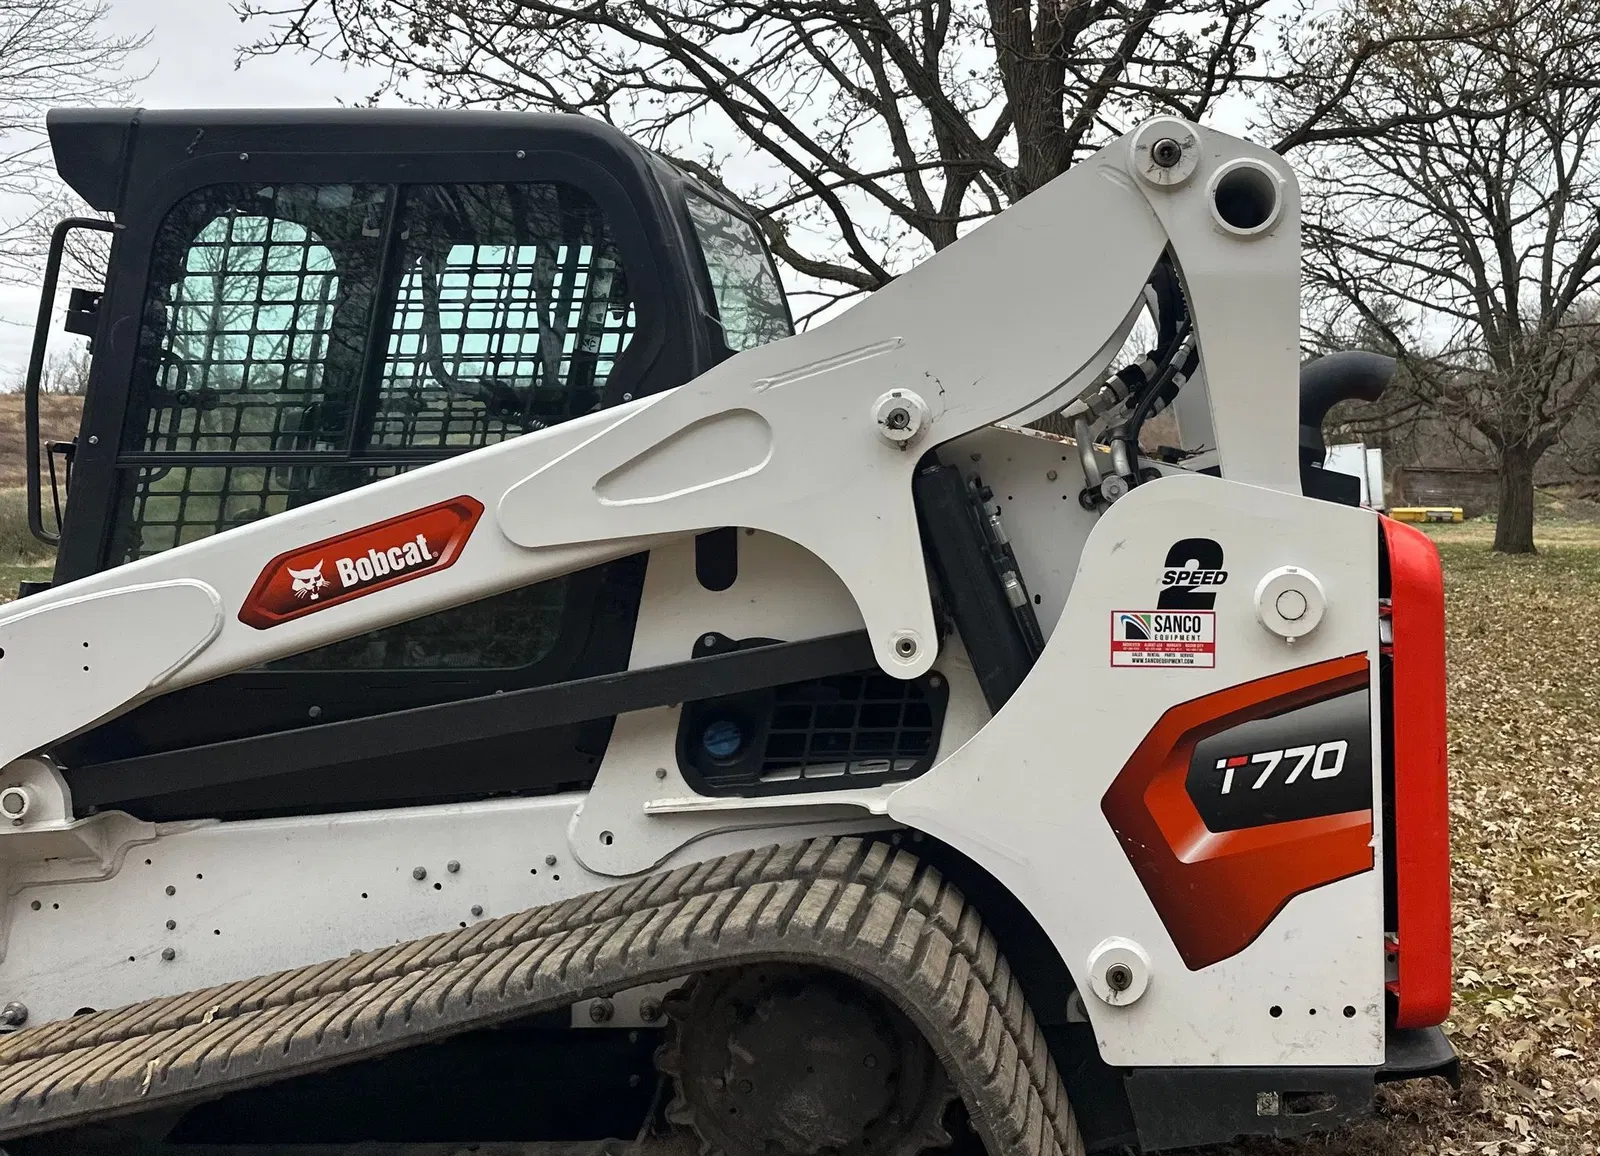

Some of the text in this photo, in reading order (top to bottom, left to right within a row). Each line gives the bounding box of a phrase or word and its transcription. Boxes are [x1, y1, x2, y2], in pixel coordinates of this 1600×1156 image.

[335, 533, 433, 588] Bobcat
[1157, 538, 1224, 610] 2
[1162, 570, 1229, 586] SPEED
[1154, 615, 1201, 633] SANCO
[1216, 739, 1348, 795] T770
